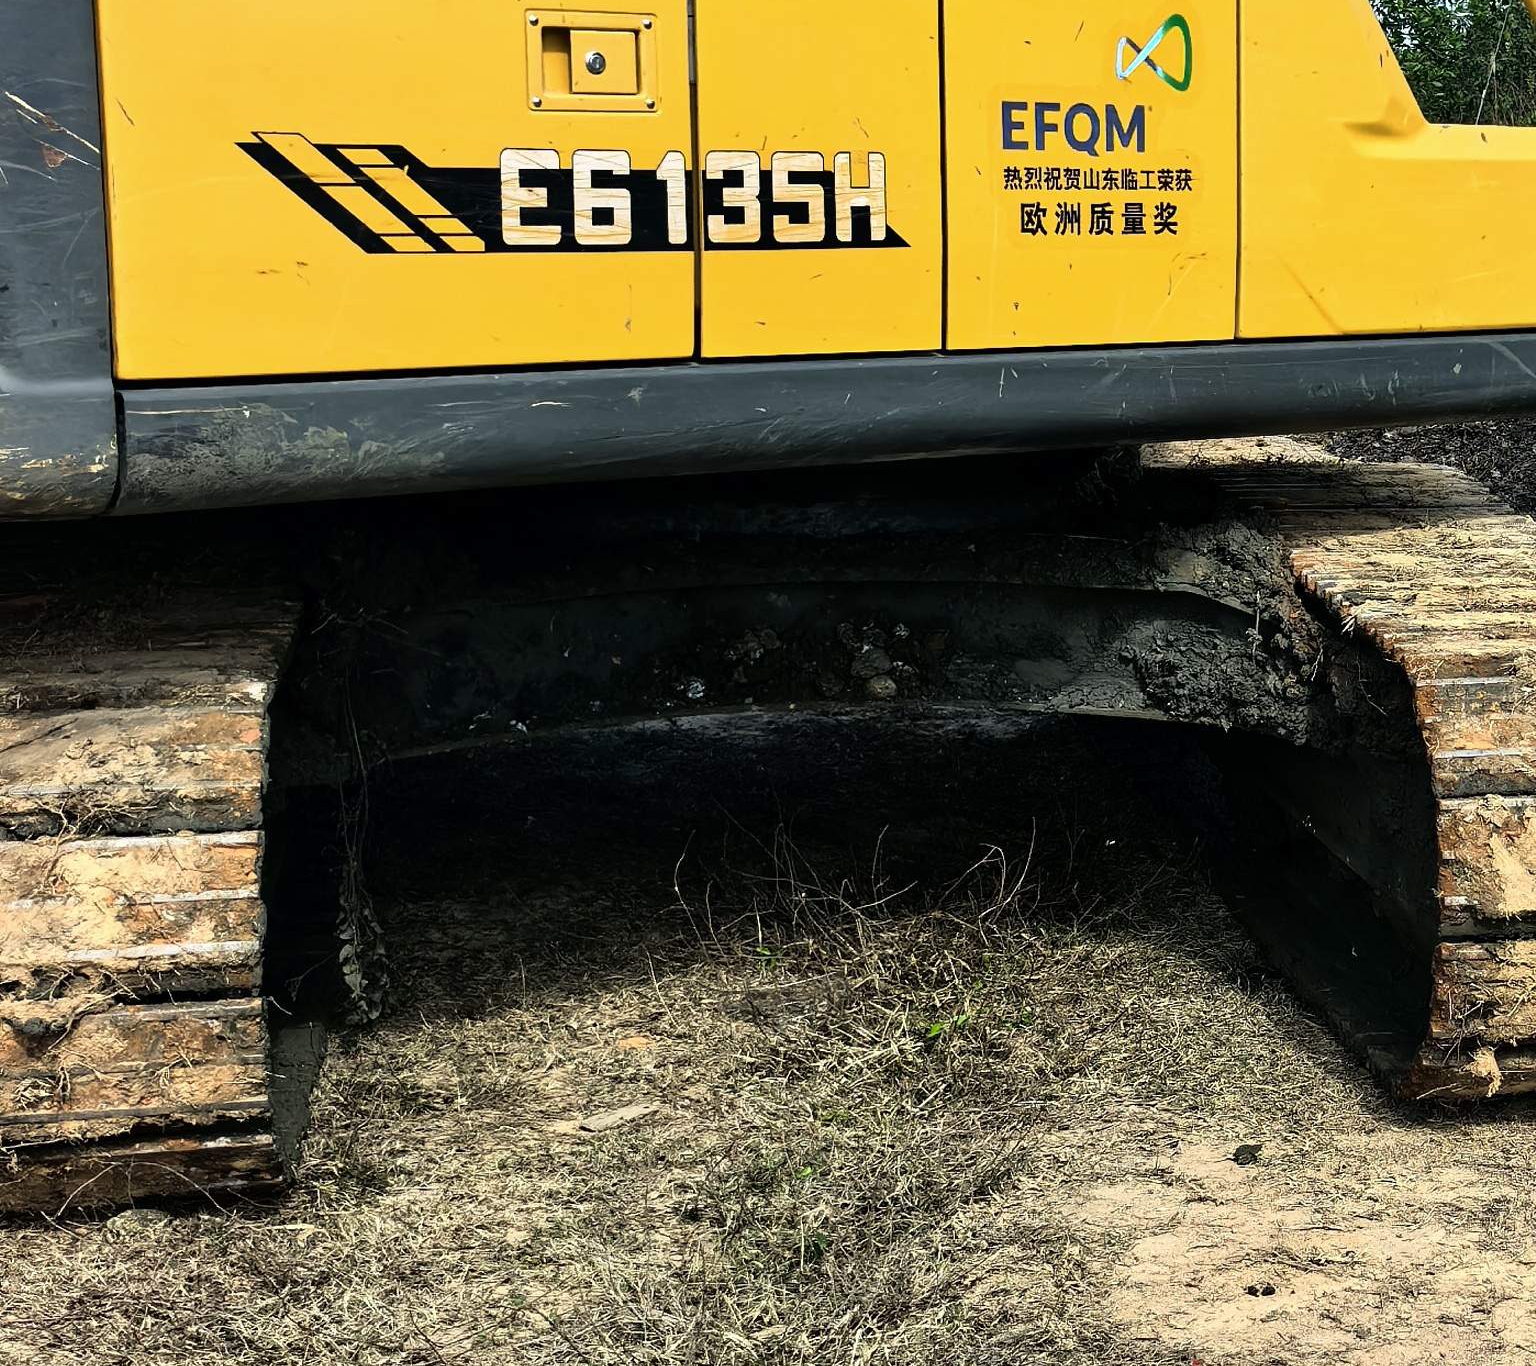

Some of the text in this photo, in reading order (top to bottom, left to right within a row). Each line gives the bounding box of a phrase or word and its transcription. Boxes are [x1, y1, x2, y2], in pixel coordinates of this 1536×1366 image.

[1001, 100, 1146, 157] EFQM
[499, 147, 887, 246] E6135H
[1003, 166, 1193, 192] 热烈祝贺山东临工荣获
[1020, 201, 1179, 236] 欧洲质量奖
